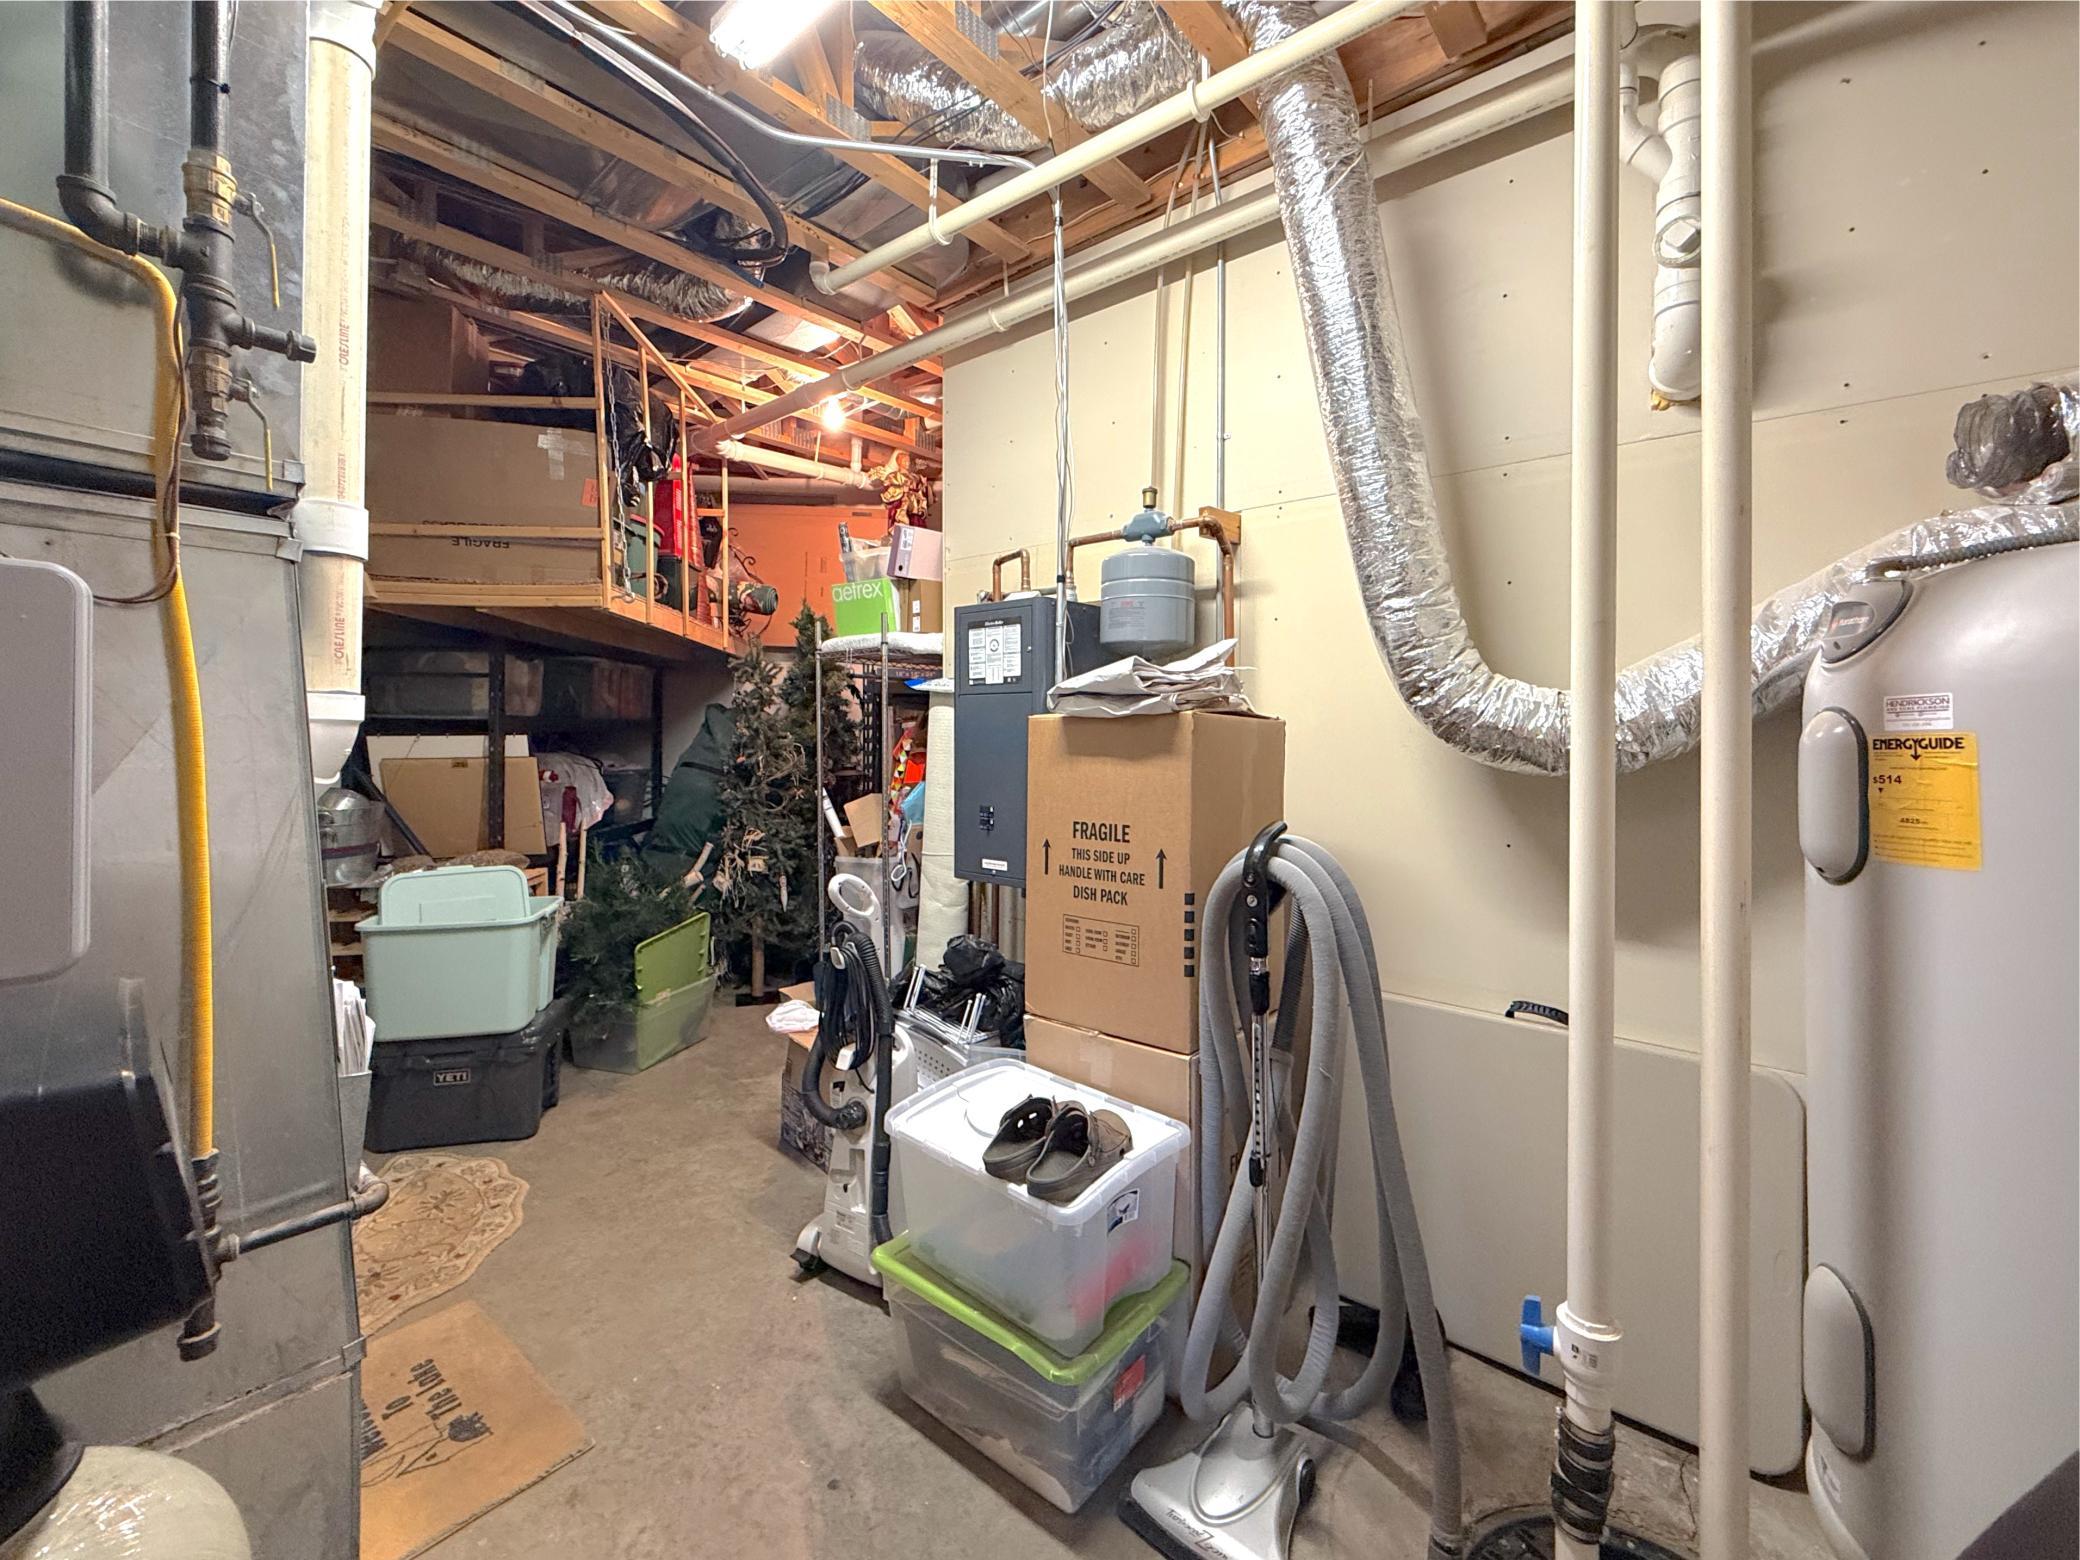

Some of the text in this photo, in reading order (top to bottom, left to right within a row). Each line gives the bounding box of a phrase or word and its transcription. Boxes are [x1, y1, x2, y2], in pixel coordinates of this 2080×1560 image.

[451, 536, 510, 548] FRAGILE
[832, 582, 884, 602] aetrex
[334, 617, 345, 660] CRESLINE
[1886, 698, 1950, 708] HENDRICKSON
[1873, 775, 1903, 785] $514
[1072, 821, 1131, 843] FRAGILE
[1072, 848, 1131, 865] THIS SIDE UP
[1059, 864, 1145, 886] HANDLE WITH CARE
[1073, 885, 1128, 906] DISH PACK
[436, 1072, 467, 1082] YETI
[408, 1358, 462, 1420] The Lake
[382, 1395, 414, 1421] To
